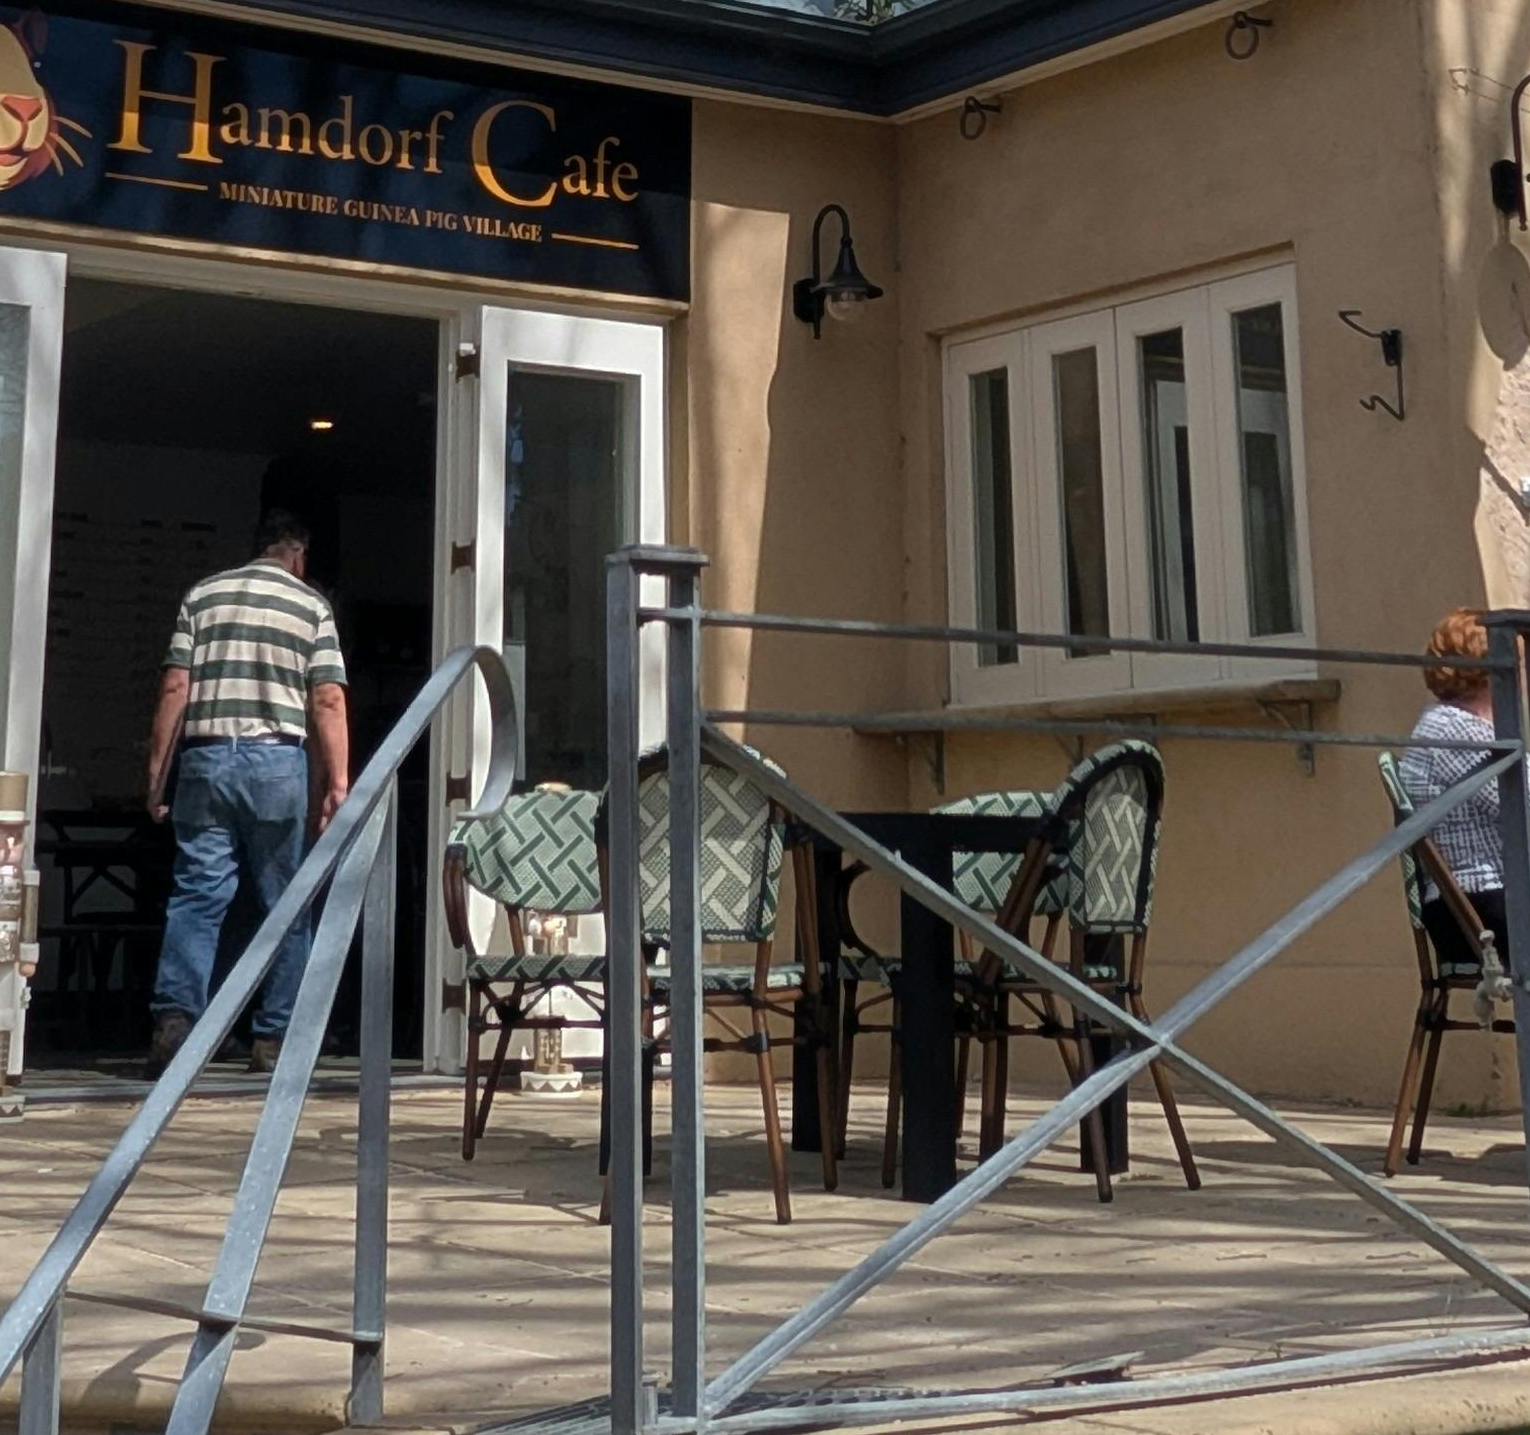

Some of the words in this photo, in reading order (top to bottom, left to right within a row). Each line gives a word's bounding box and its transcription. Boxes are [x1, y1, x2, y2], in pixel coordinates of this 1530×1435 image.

[106, 39, 453, 173] Hamdorf
[472, 99, 639, 209] Cafe
[220, 181, 338, 215] MINIATURE
[343, 198, 420, 226] GUINEA
[425, 209, 458, 230] PIG
[462, 214, 542, 242] VILLAGE
